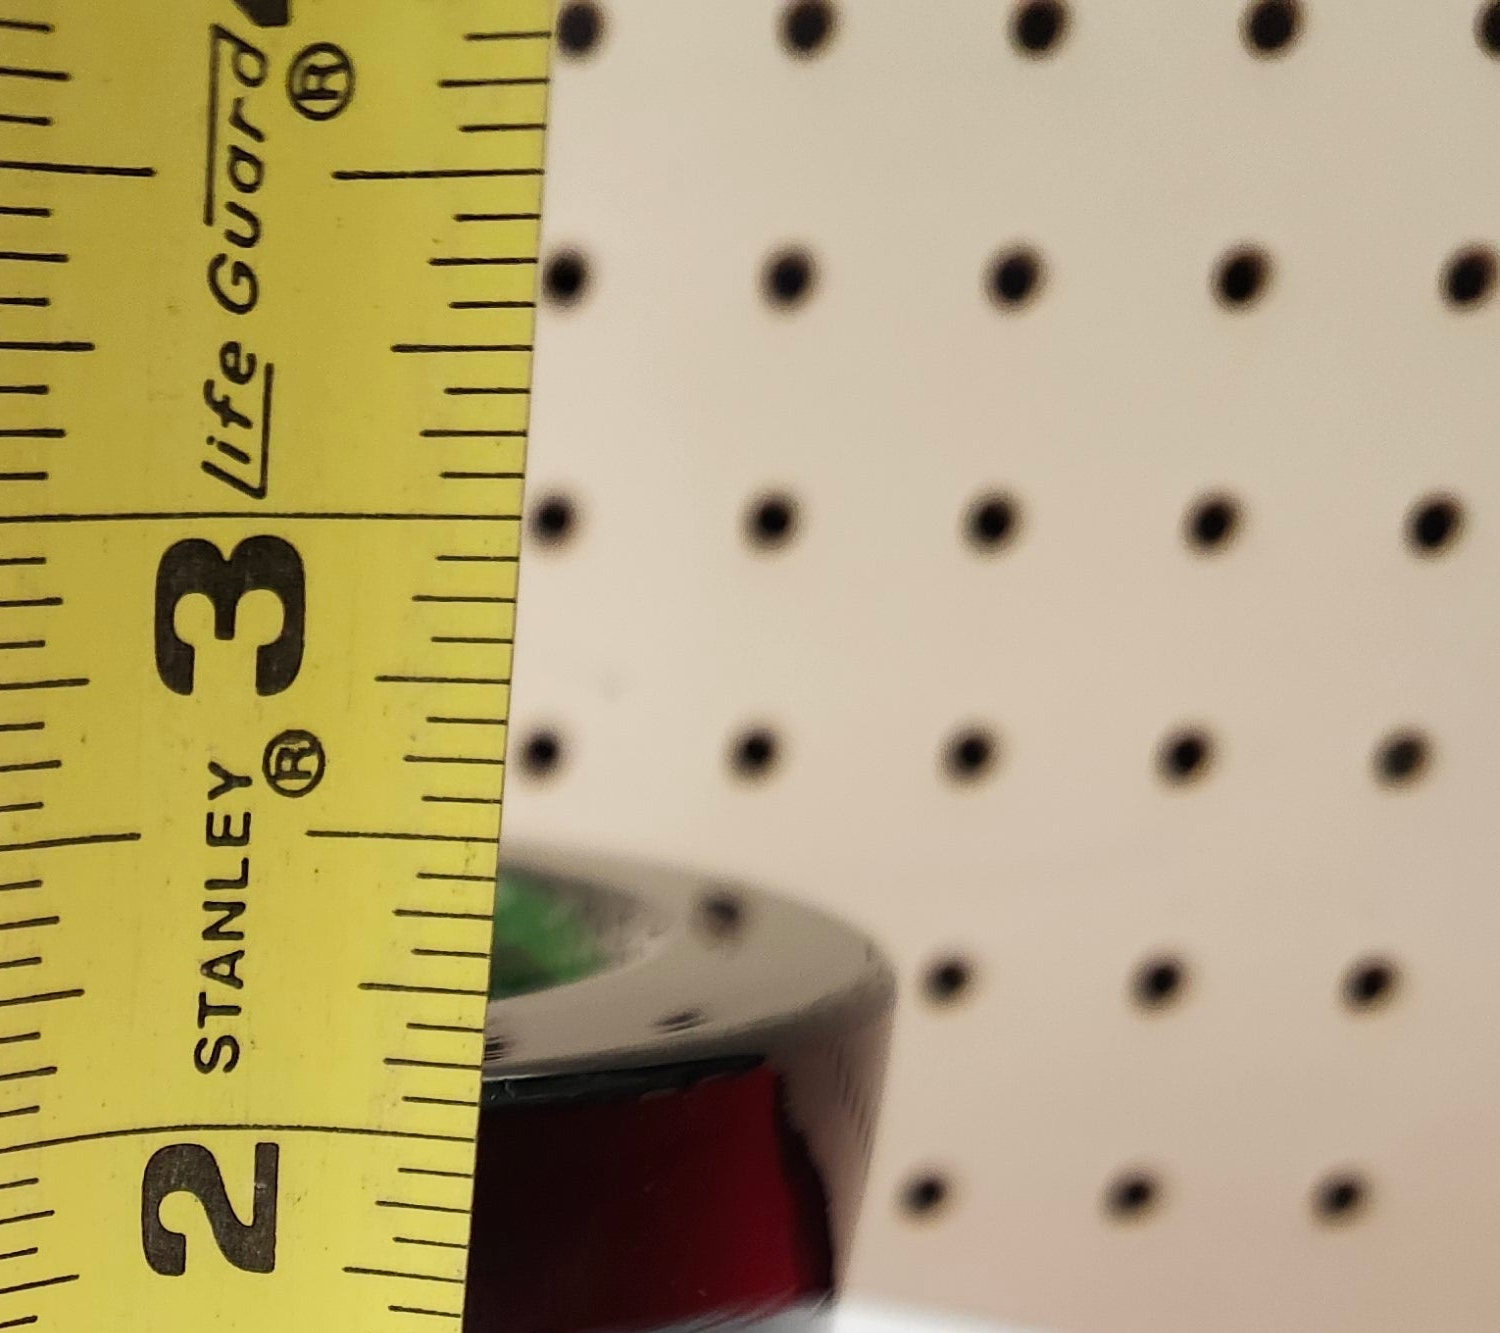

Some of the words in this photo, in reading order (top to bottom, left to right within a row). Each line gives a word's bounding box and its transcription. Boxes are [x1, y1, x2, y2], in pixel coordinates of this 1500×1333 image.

[205, 24, 269, 315] Guard
[154, 534, 306, 697] 3
[194, 760, 253, 1075] STANLEY
[141, 1142, 279, 1277] 2
